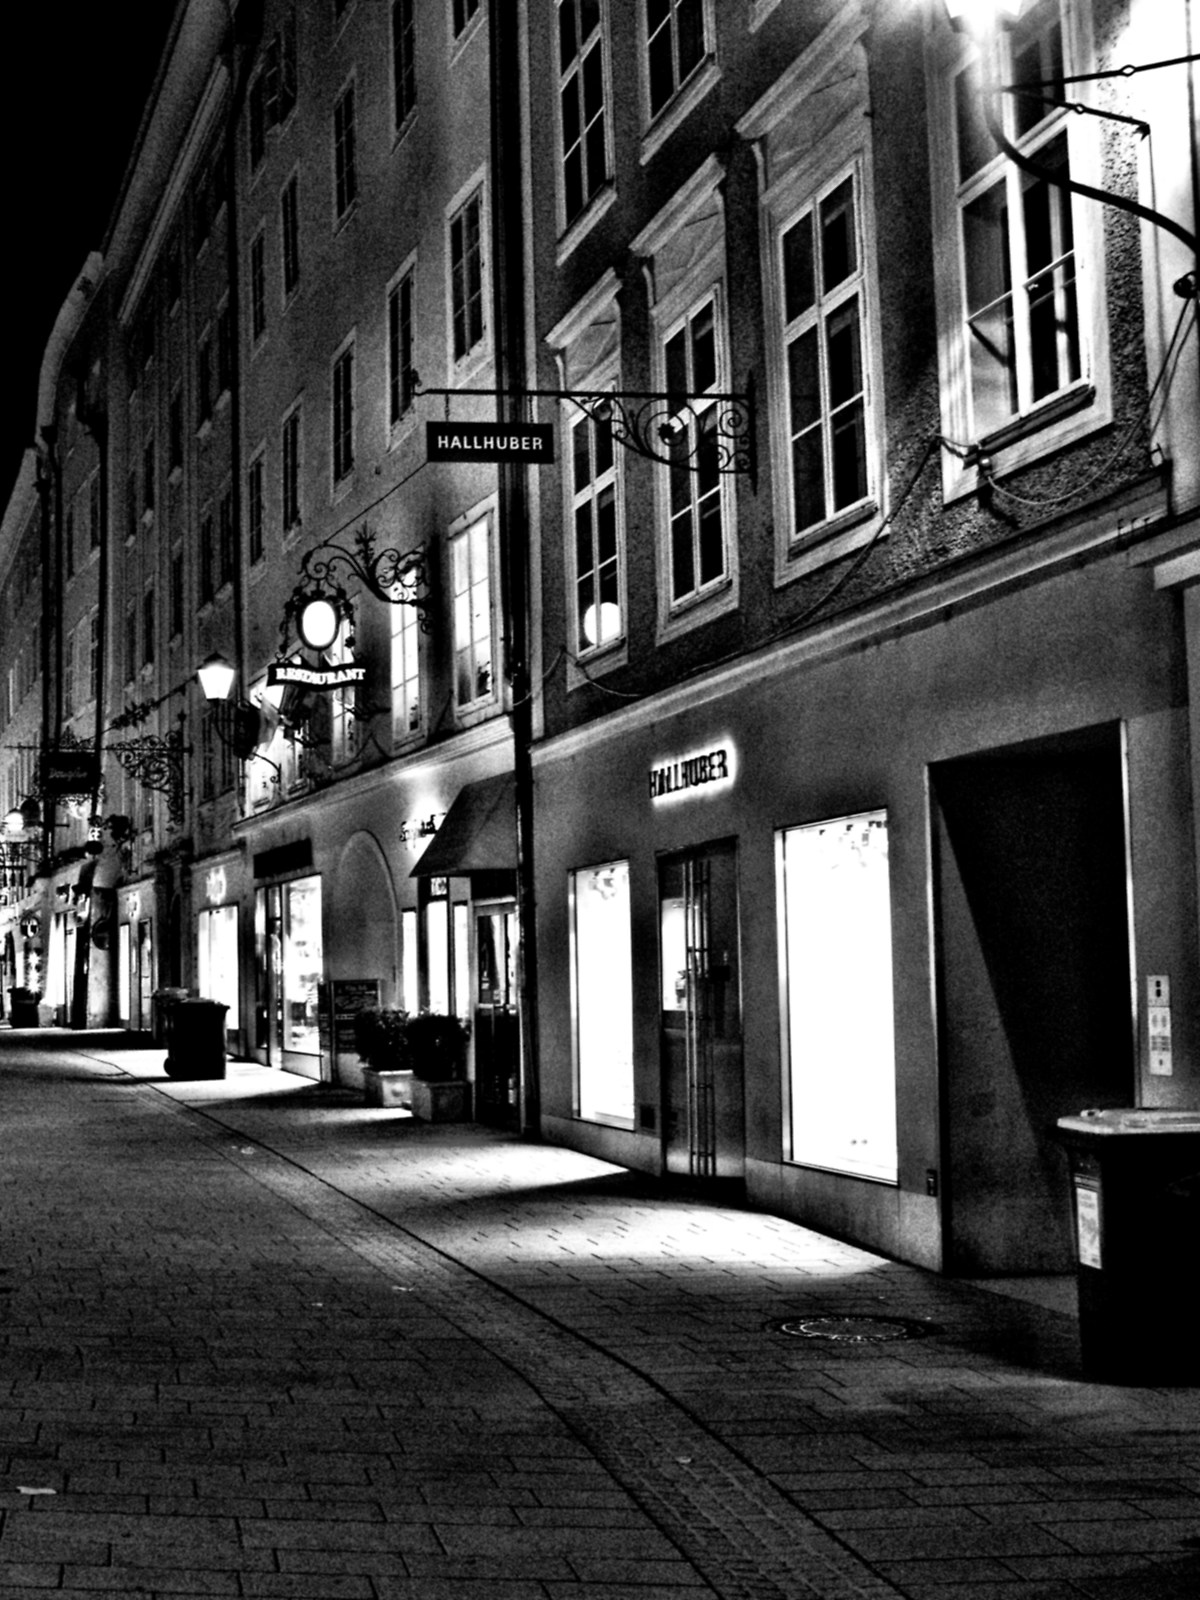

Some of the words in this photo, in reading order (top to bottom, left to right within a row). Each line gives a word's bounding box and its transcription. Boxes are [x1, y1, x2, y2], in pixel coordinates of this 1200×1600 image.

[436, 434, 545, 451] HALLHUBER
[275, 667, 366, 685] RESTAURANT
[648, 749, 728, 799] HALLHUBER
